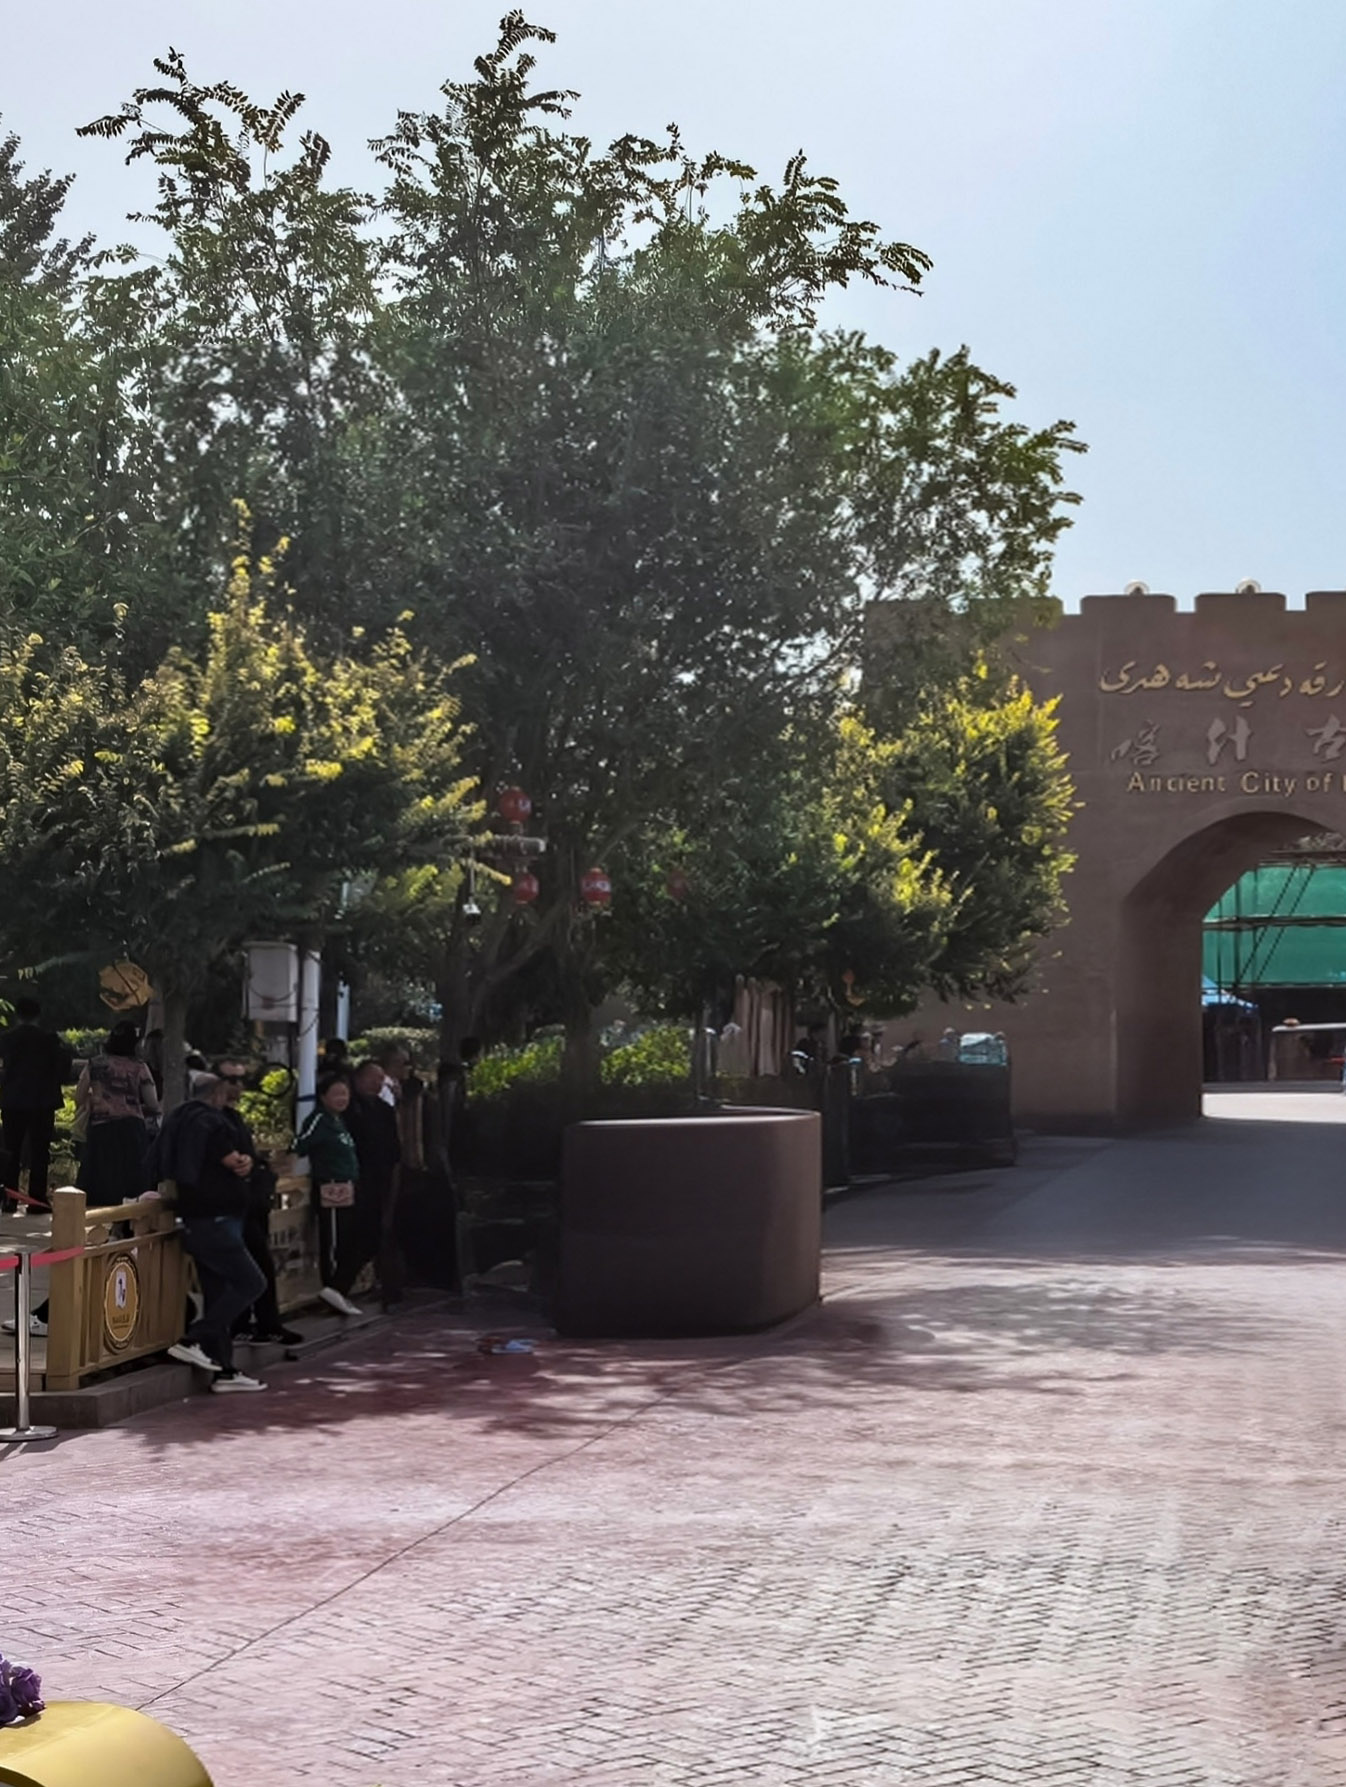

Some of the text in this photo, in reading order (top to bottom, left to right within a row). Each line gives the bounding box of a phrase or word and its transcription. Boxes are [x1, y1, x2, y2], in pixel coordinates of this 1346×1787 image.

[1127, 771, 1225, 793] Ancient
[1241, 772, 1296, 796] City
[1307, 772, 1332, 793] of
